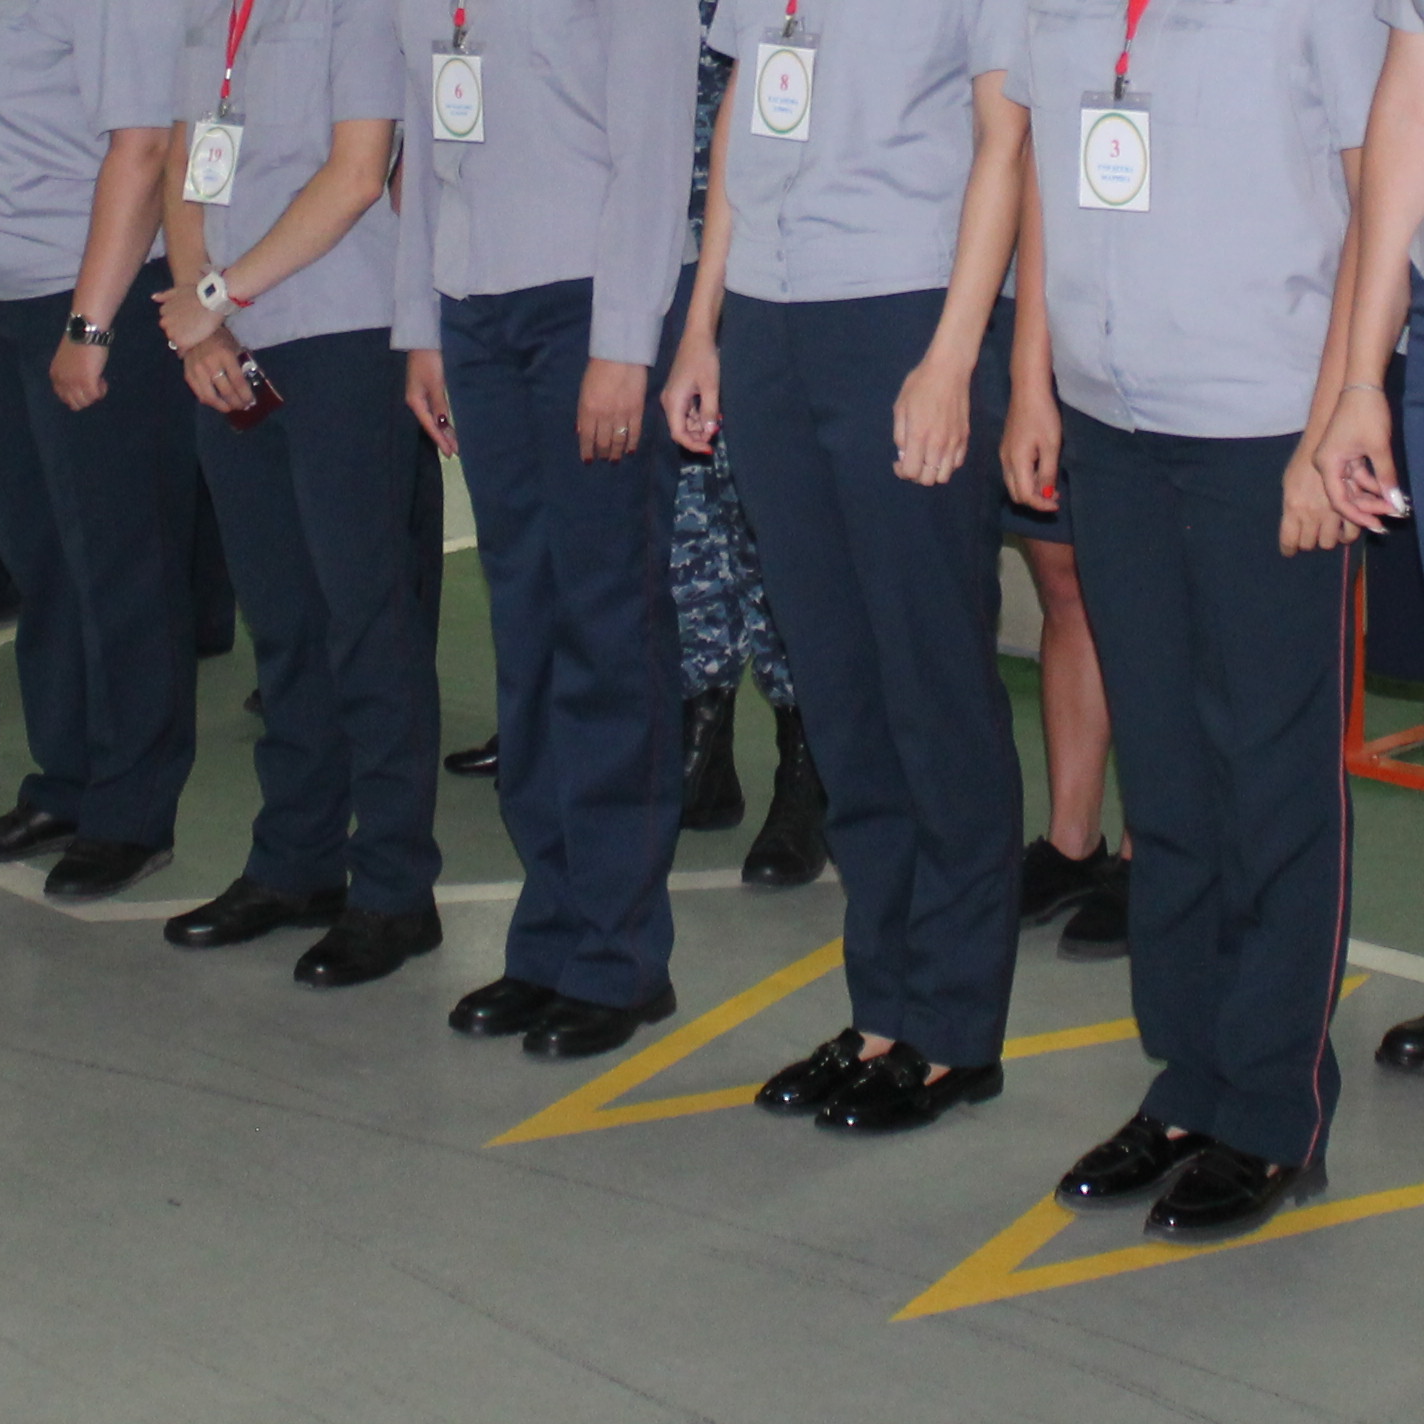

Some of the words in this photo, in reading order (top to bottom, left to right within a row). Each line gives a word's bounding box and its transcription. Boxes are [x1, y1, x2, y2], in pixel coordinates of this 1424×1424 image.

[779, 74, 789, 91] 8
[454, 83, 463, 100] 6
[1109, 138, 1121, 158] 3
